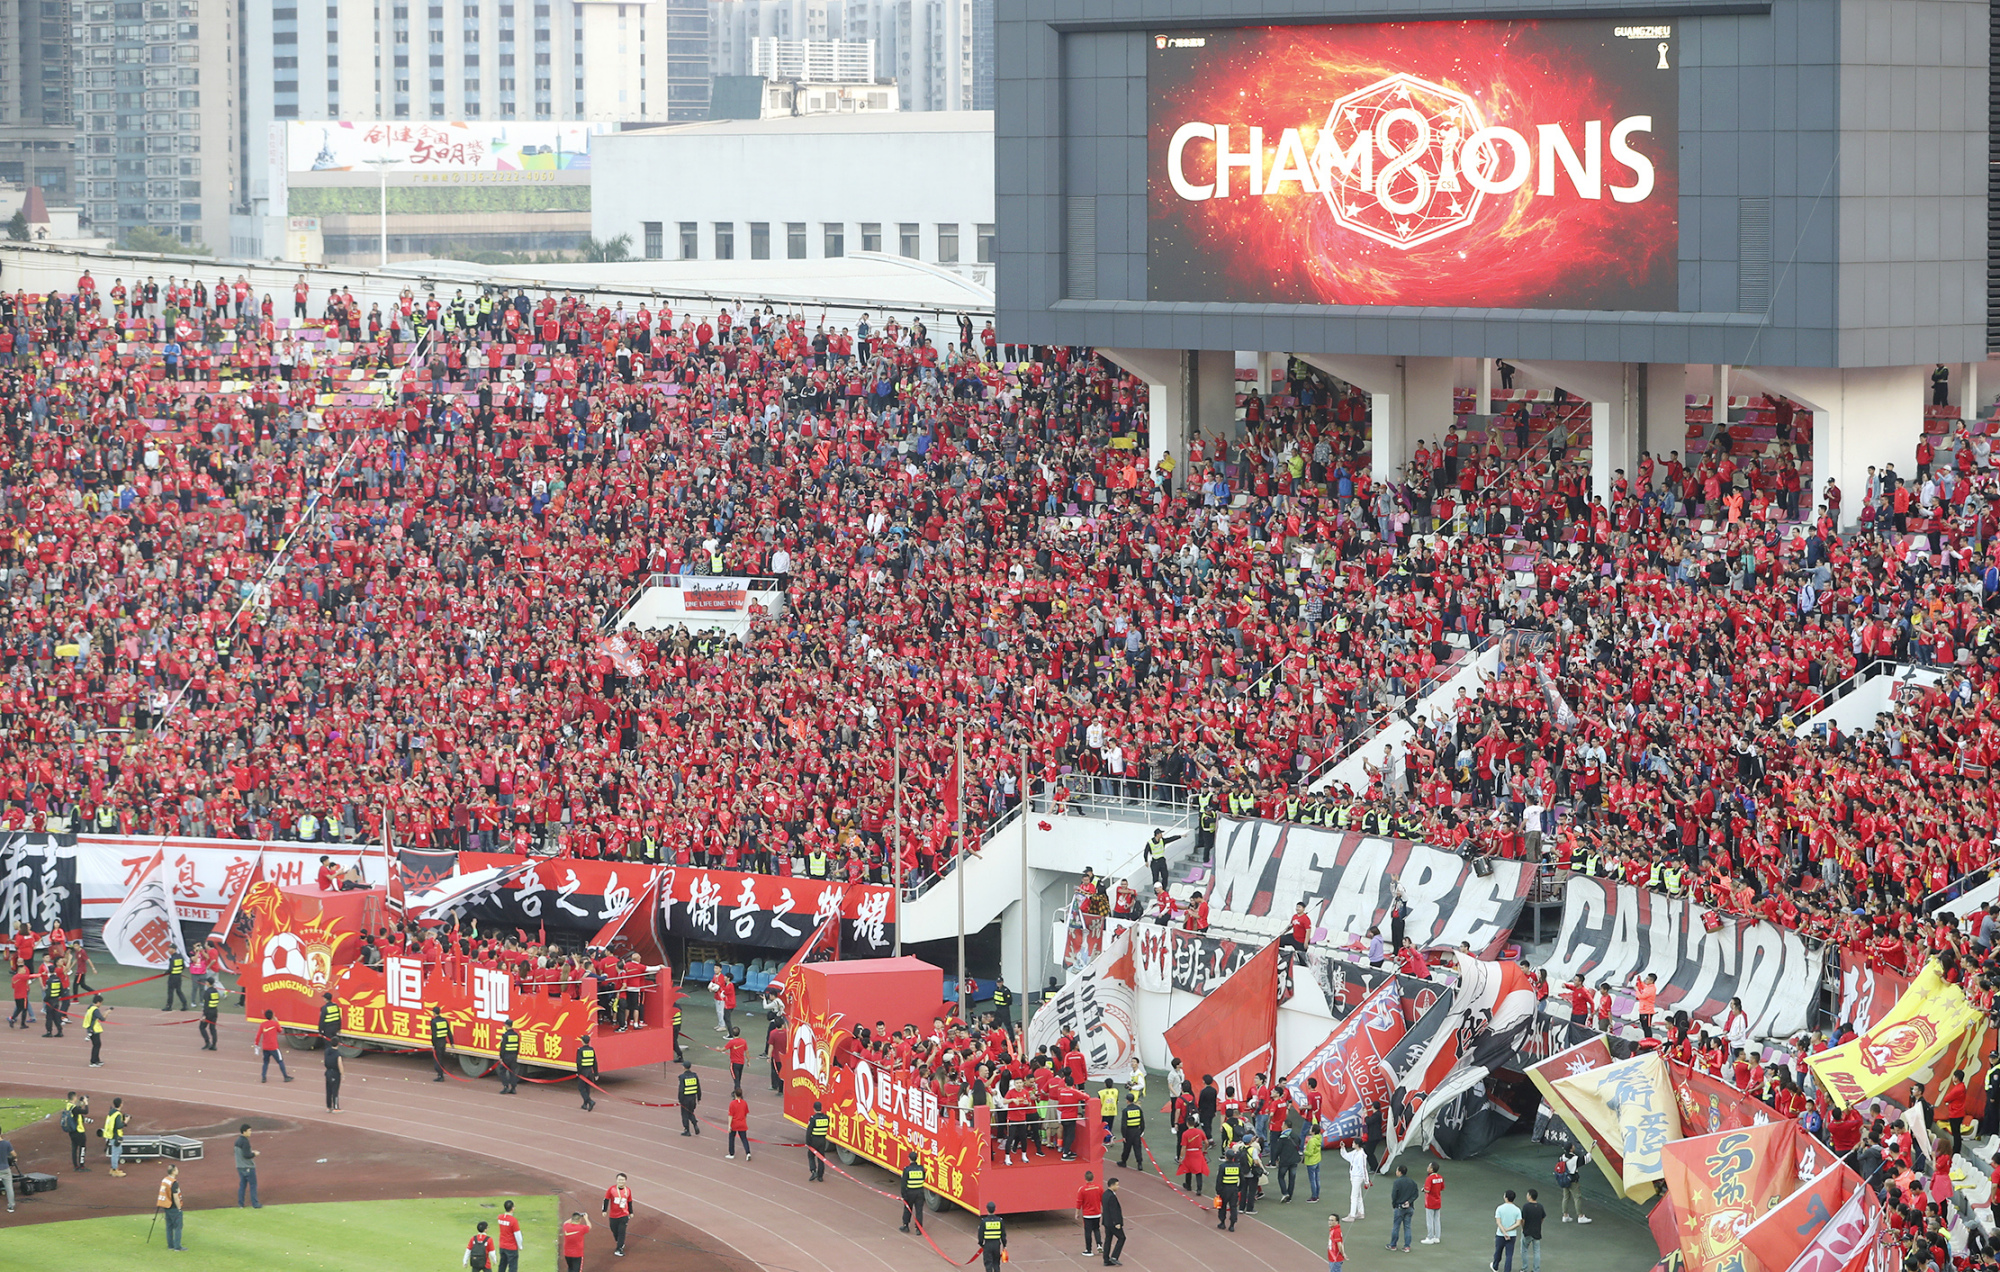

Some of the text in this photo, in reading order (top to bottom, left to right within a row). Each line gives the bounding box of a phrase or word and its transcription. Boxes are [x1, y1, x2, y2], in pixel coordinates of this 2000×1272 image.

[1441, 181, 1455, 189] CSL
[174, 906, 211, 919] REME
[1543, 874, 1823, 1039] CANTON
[262, 980, 314, 998] GUANGZHOU
[792, 1076, 820, 1100] GUANGZHOU
[877, 1068, 939, 1135] 恒大集团
